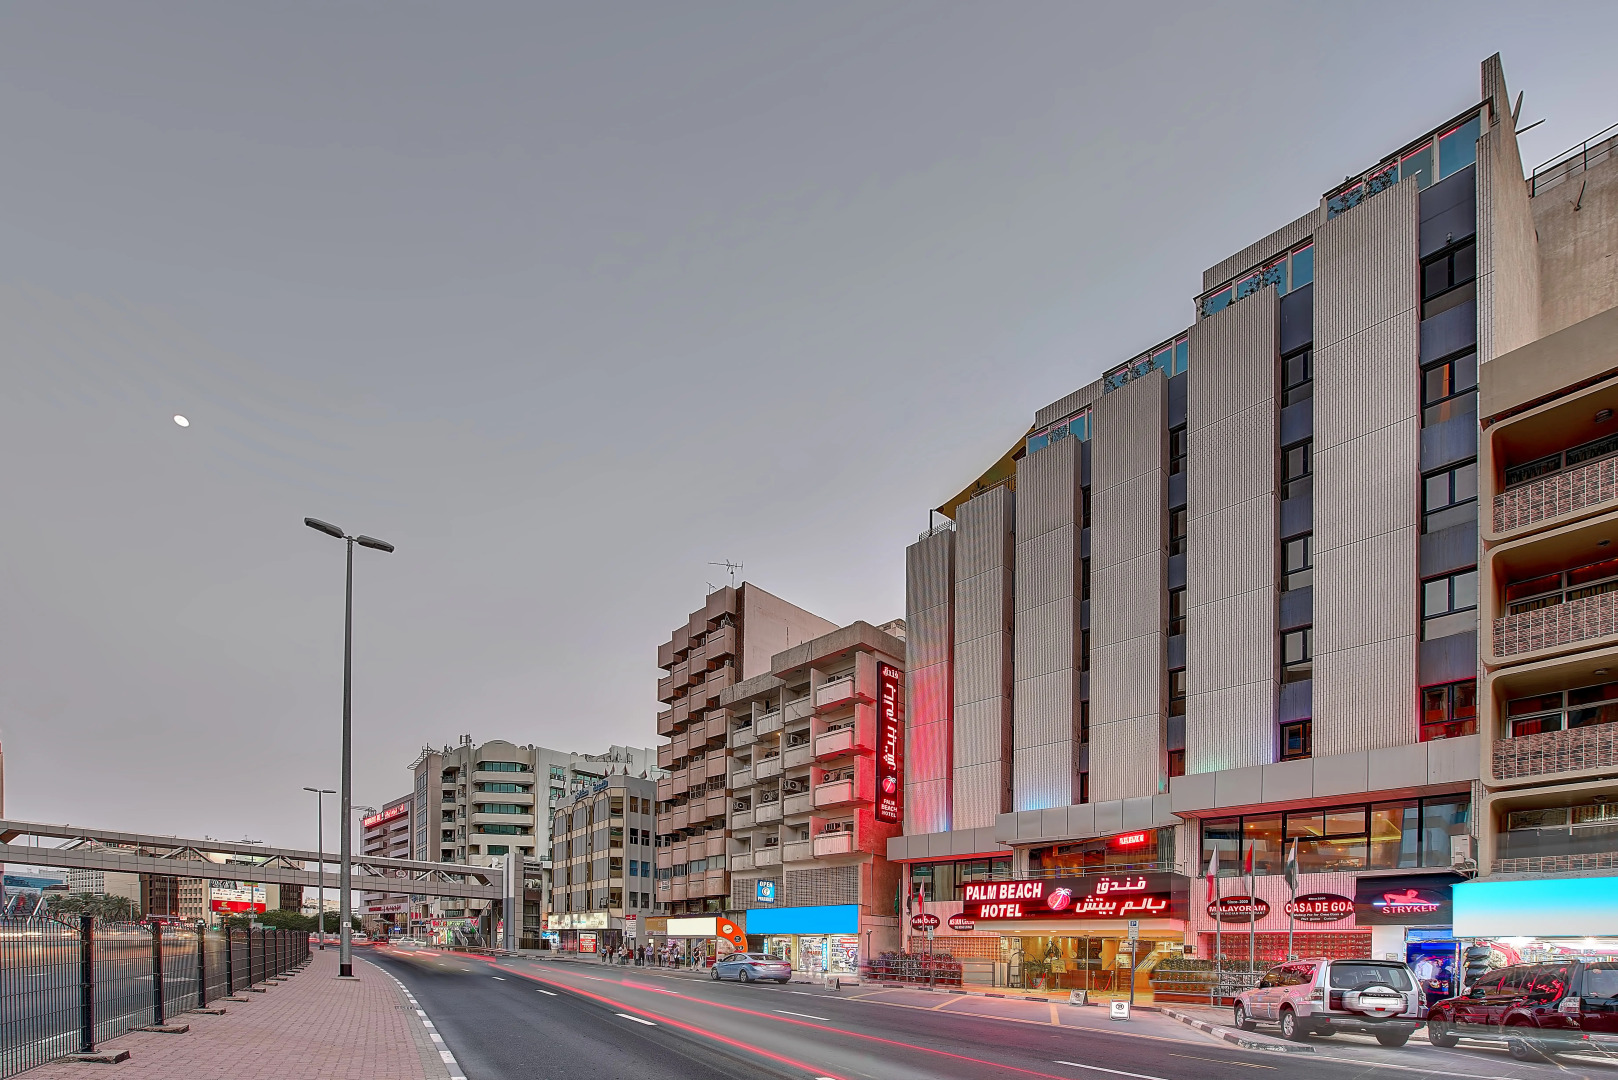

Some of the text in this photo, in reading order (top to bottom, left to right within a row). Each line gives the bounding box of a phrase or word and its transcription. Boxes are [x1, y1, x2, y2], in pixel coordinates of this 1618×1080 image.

[881, 804, 897, 812] BEACH
[883, 798, 895, 806] PALM
[881, 810, 896, 818] HOTEL
[966, 882, 1042, 900] PALM BEACH
[1096, 877, 1146, 894] فندق
[980, 904, 1022, 918] HOTEL
[1075, 895, 1167, 916] بالم بيتش
[1285, 901, 1354, 913] CASA DE GOA
[1382, 905, 1438, 914] STRYKER
